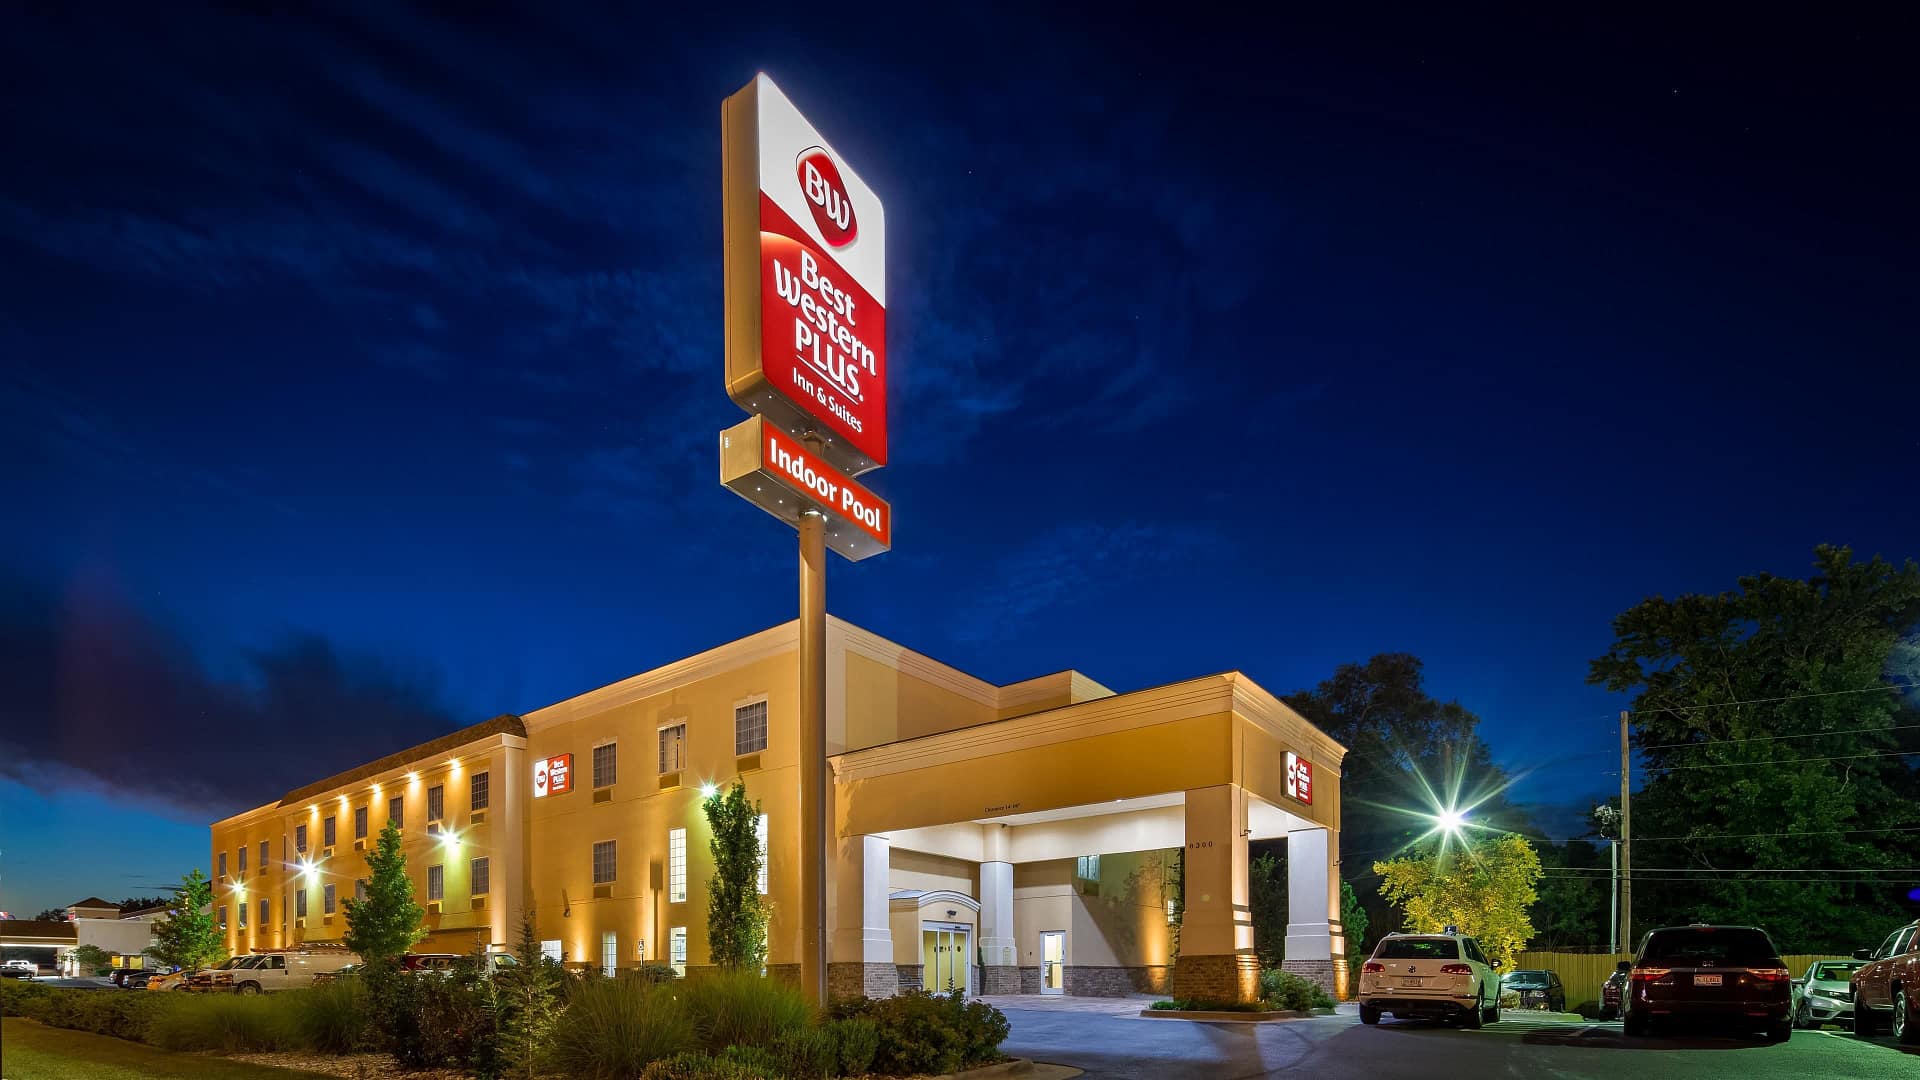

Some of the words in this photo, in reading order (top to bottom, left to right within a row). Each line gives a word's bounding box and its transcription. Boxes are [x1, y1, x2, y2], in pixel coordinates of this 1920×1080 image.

[805, 159, 850, 231] BW
[773, 258, 877, 377] Western
[801, 249, 856, 326] Best
[793, 367, 815, 396] Inn
[816, 384, 827, 407] &
[828, 397, 863, 433] Suites
[770, 437, 838, 502] Indoor
[841, 487, 881, 532] Pool
